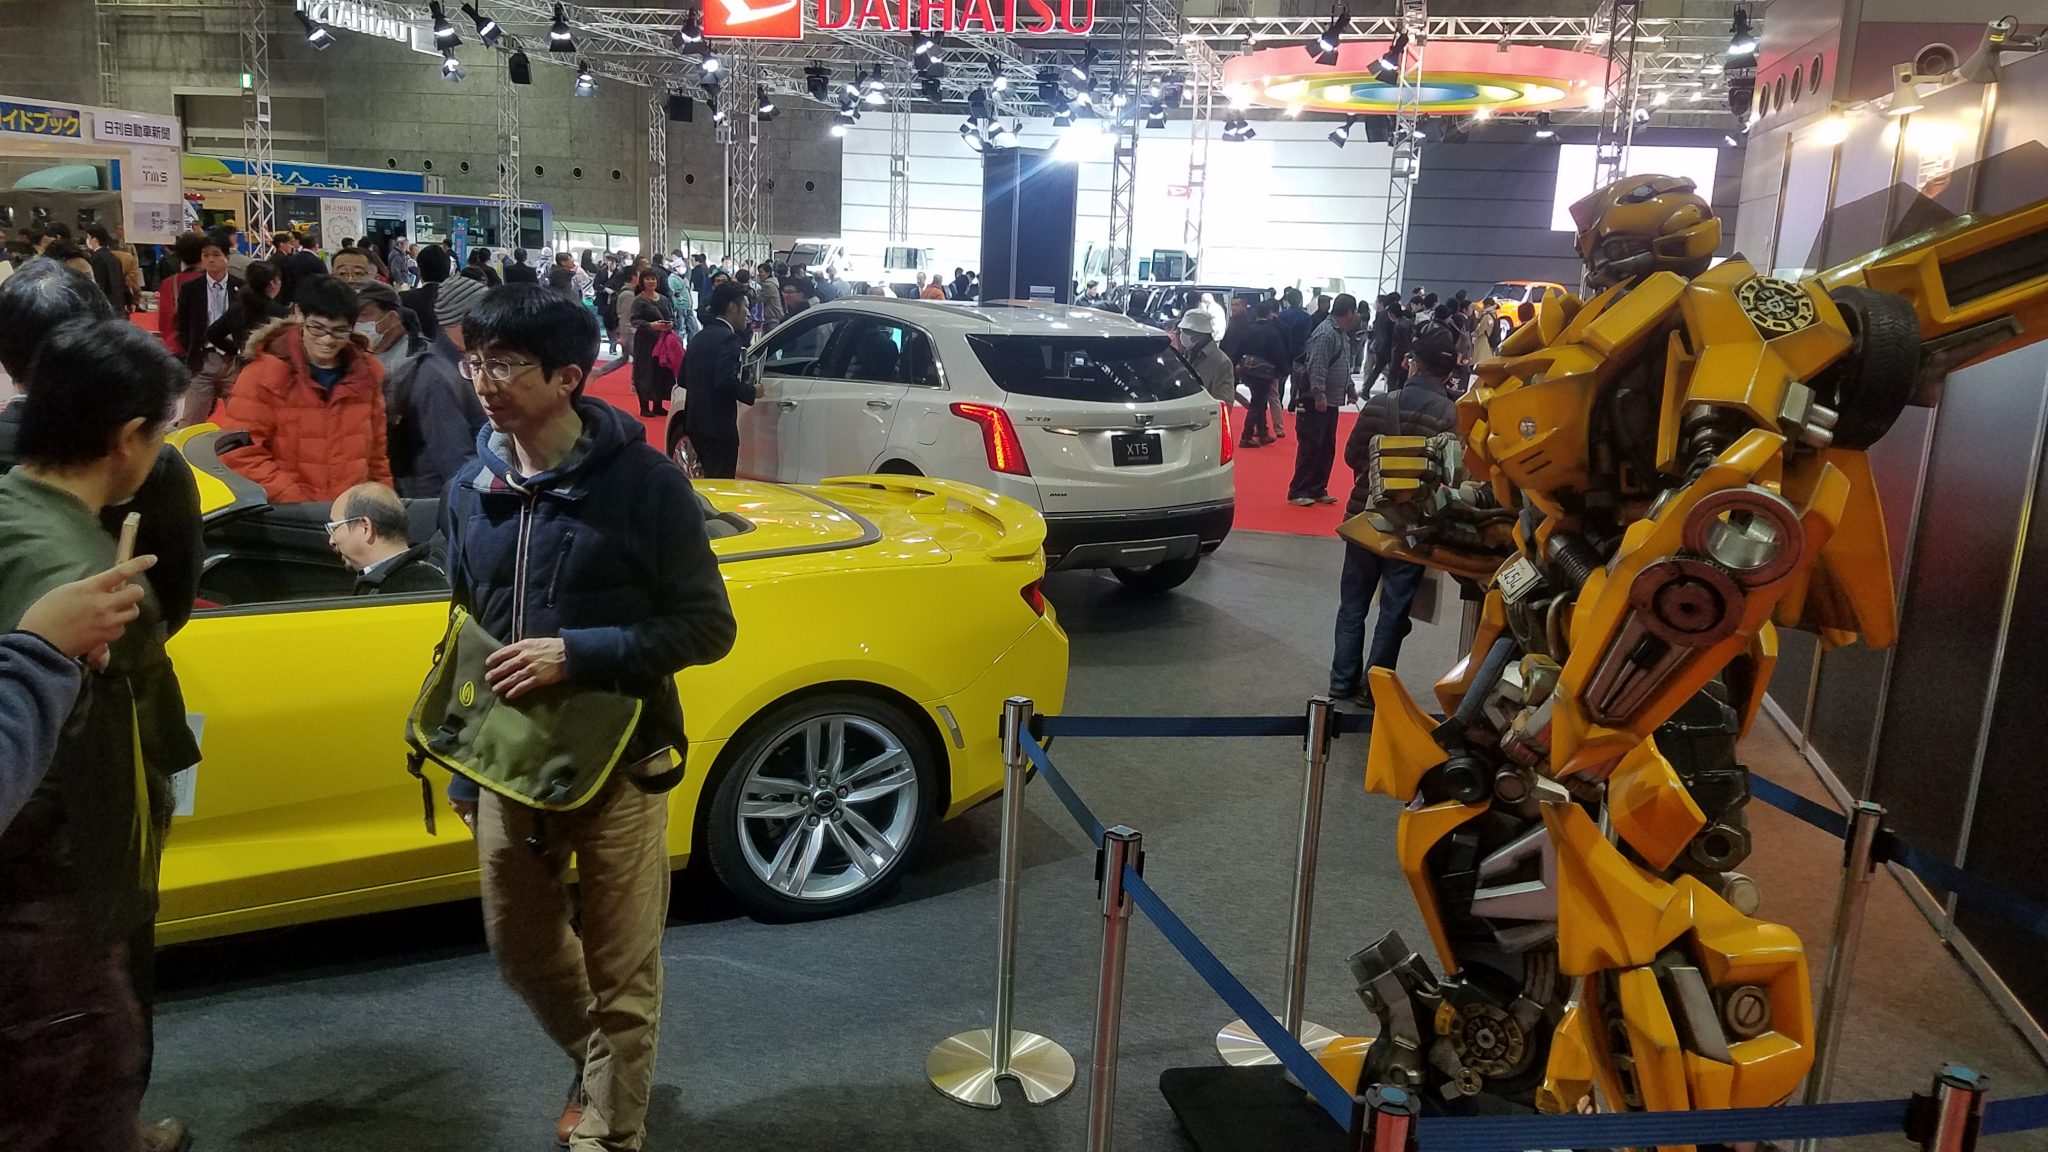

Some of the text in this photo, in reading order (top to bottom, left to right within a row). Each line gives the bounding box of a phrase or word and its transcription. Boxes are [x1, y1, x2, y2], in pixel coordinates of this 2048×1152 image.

[817, 0, 1096, 34] DAIHATSU
[0, 109, 79, 136] イドブック
[104, 121, 171, 141] 日刊自動車新聞
[1126, 443, 1149, 456] XT5
[1501, 565, 1522, 589] 454
